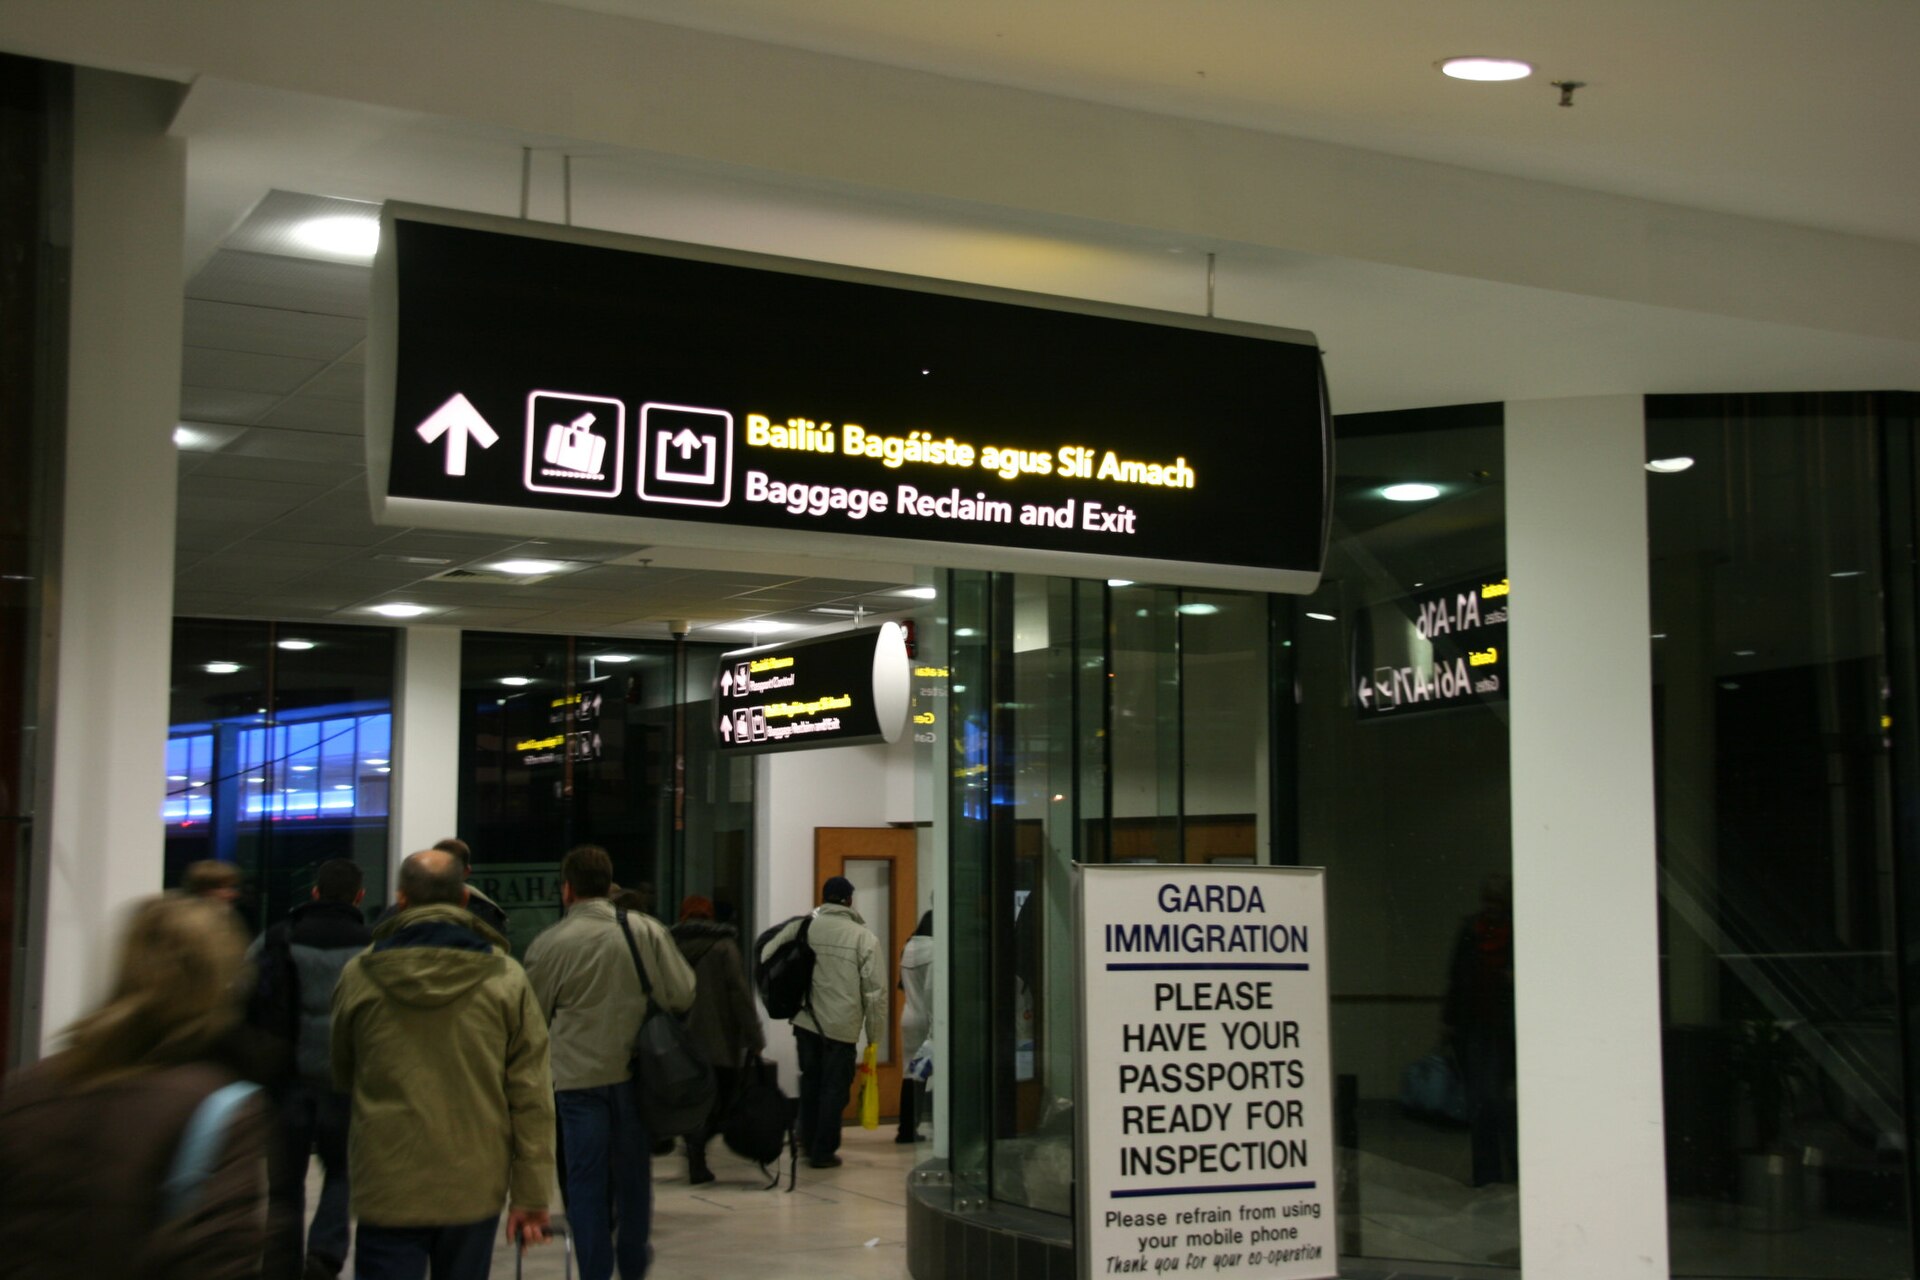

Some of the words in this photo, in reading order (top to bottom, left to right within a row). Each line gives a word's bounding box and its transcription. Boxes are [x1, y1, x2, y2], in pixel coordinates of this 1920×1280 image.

[746, 414, 835, 454] Bailiú
[843, 424, 976, 468] Bagáiste
[980, 446, 1053, 480] agus
[1057, 445, 1096, 479] Slí
[1097, 451, 1196, 489] Amach
[746, 471, 889, 520] Baggage
[897, 485, 1013, 524] Reclaim
[1020, 499, 1075, 529] and
[1082, 502, 1137, 535] Exit
[1158, 884, 1266, 913] GARDA
[1105, 924, 1308, 953] IMMIGRATION
[1155, 982, 1273, 1011] PLEASE
[1123, 1023, 1207, 1052] HAVE
[1221, 1021, 1300, 1050] YOUR
[1119, 1060, 1304, 1093] PASSPORTS
[1122, 1103, 1232, 1135] READY
[1247, 1100, 1304, 1130] FOR
[1120, 1139, 1307, 1176] INSPECTION
[1105, 1211, 1167, 1228] Please
[1176, 1206, 1232, 1225] refrain
[1239, 1204, 1276, 1221] from
[1282, 1201, 1321, 1219] using
[1138, 1235, 1178, 1252] your
[1186, 1228, 1243, 1247] mobile
[1251, 1225, 1298, 1246] phone
[1106, 1255, 1148, 1274] Thank
[1154, 1256, 1179, 1275] you
[1185, 1252, 1207, 1270] for
[1213, 1252, 1242, 1272] your
[1248, 1244, 1323, 1267] co-operation
